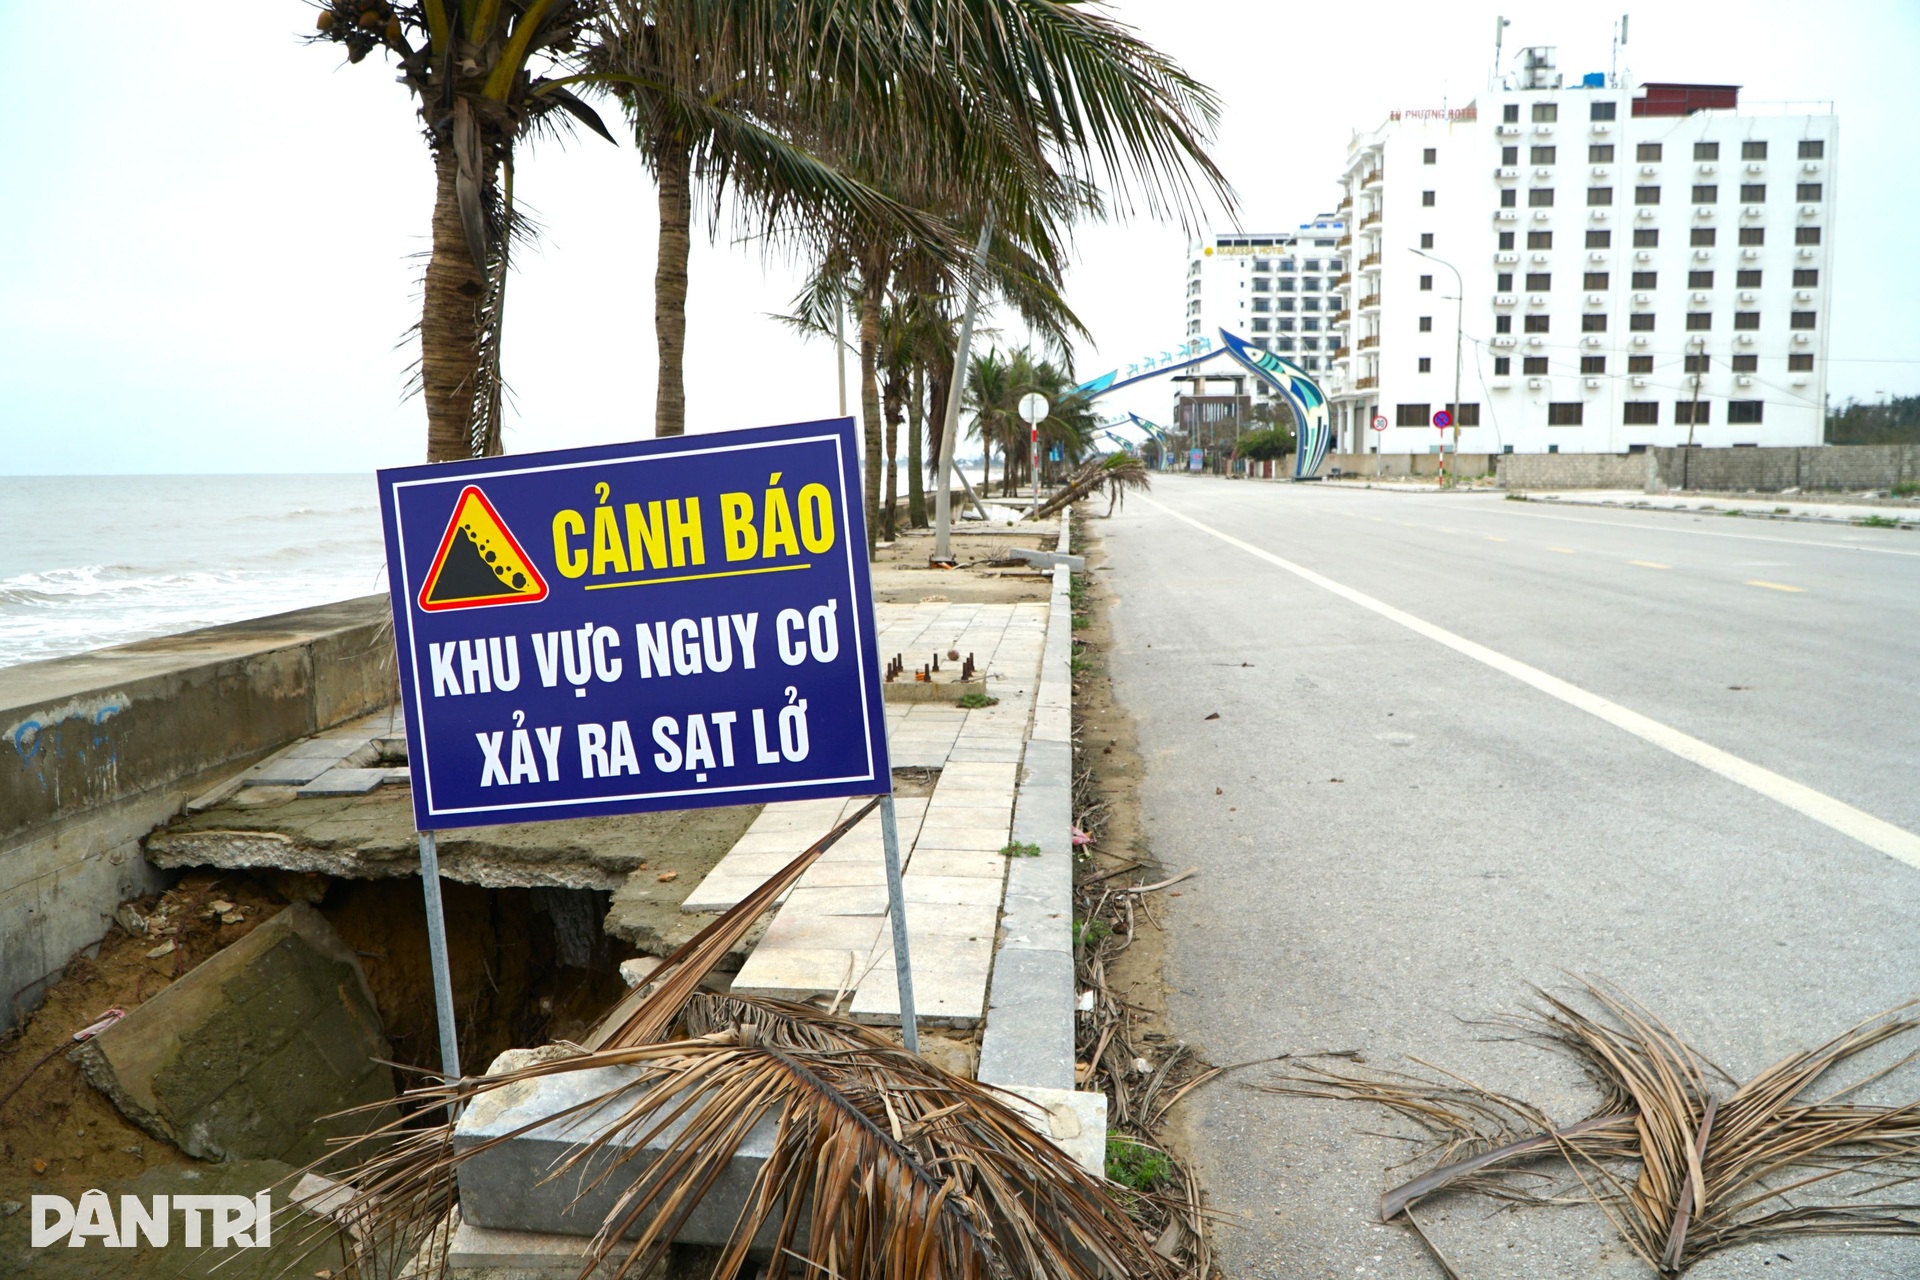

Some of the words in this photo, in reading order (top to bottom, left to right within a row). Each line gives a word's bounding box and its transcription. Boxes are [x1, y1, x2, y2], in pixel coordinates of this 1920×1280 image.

[1258, 246, 1286, 255] HOTEL
[552, 482, 706, 579] CẢNH
[720, 472, 835, 562] BÁO
[429, 635, 521, 698] KHU
[532, 621, 622, 699] VỰC
[636, 612, 759, 679] NGUY
[776, 598, 839, 666] CƠ
[475, 709, 562, 788] XẢY
[577, 720, 641, 780] RA
[652, 708, 737, 783] SẠT
[751, 685, 809, 766] LỞ
